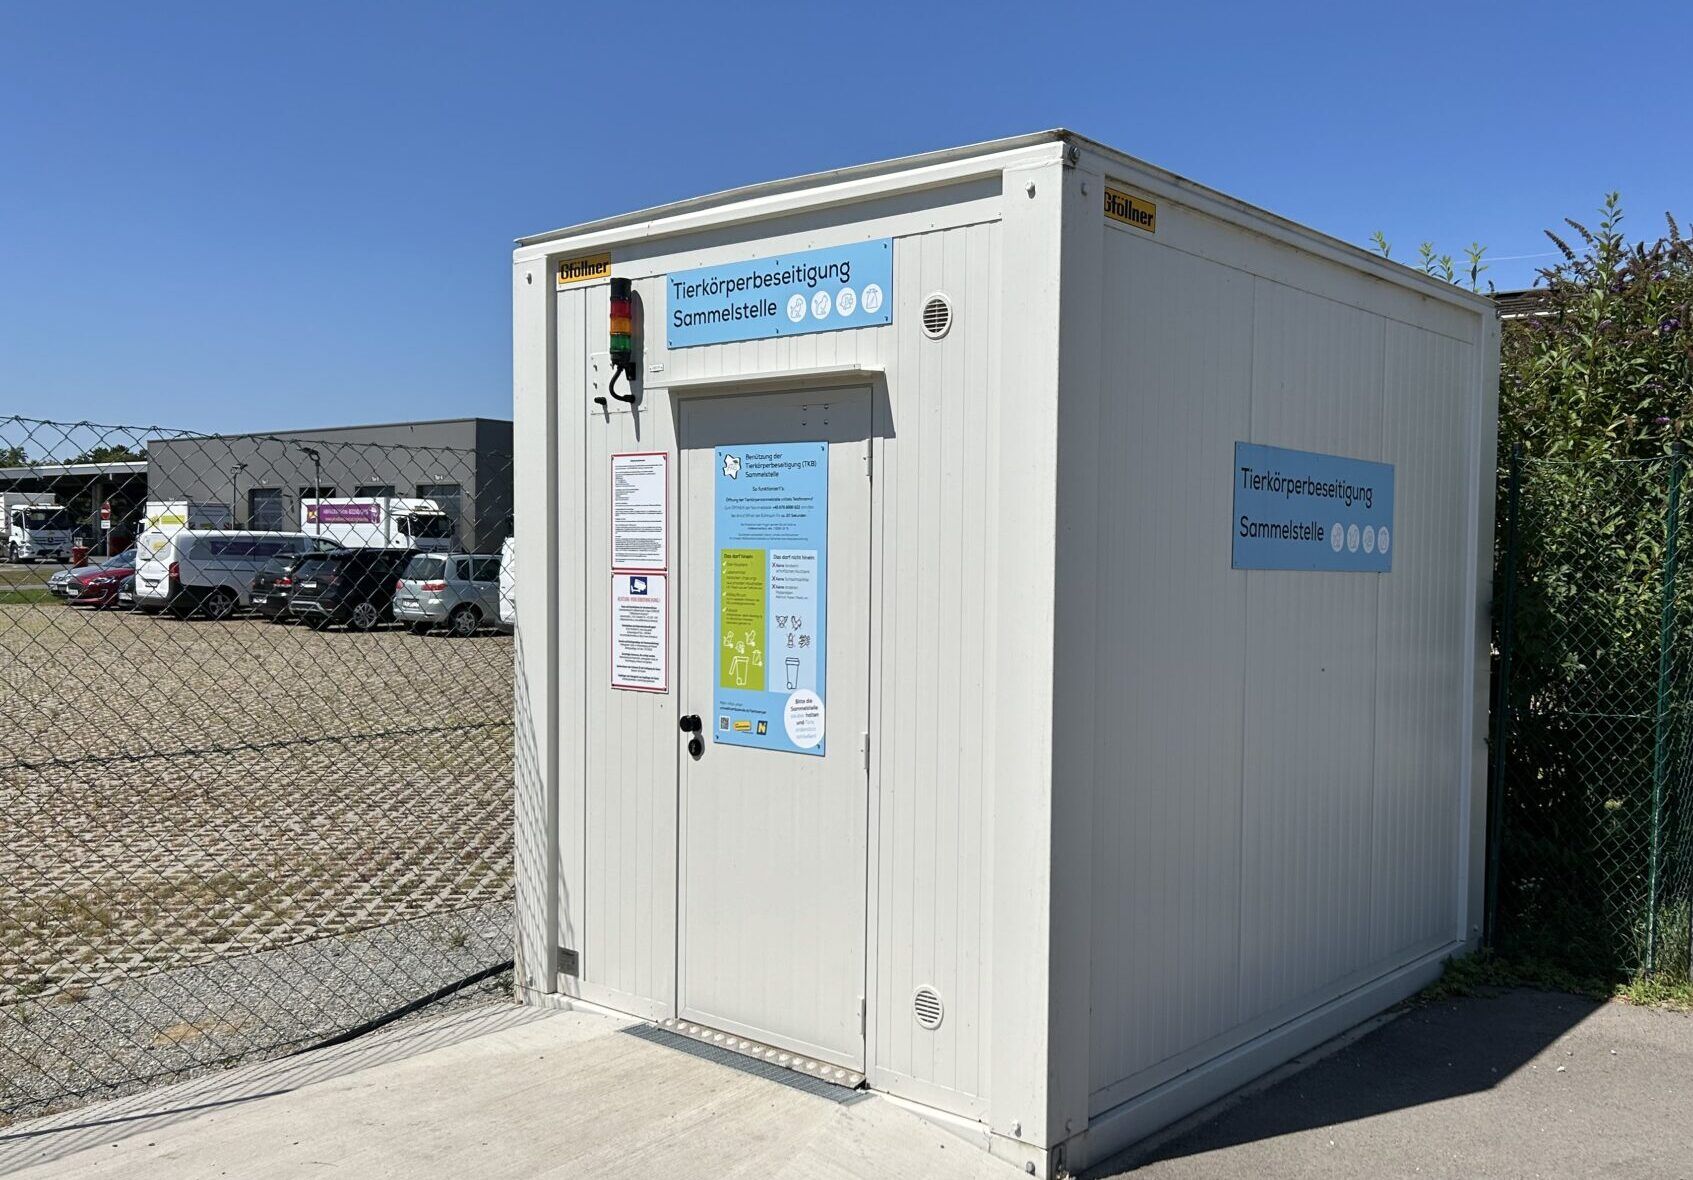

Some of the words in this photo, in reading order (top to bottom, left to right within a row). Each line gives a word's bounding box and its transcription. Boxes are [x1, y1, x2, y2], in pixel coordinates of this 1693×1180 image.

[560, 259, 609, 280] Gföllner
[673, 260, 851, 299] Tierkörperbeseitigung
[673, 298, 777, 328] Sammelstelle
[745, 462, 802, 470] Tierkörperbeseitigung
[802, 460, 817, 468] (TKB)
[1241, 466, 1374, 509] Tierkörperbeseitigung
[1239, 515, 1325, 541] Sammelstelle
